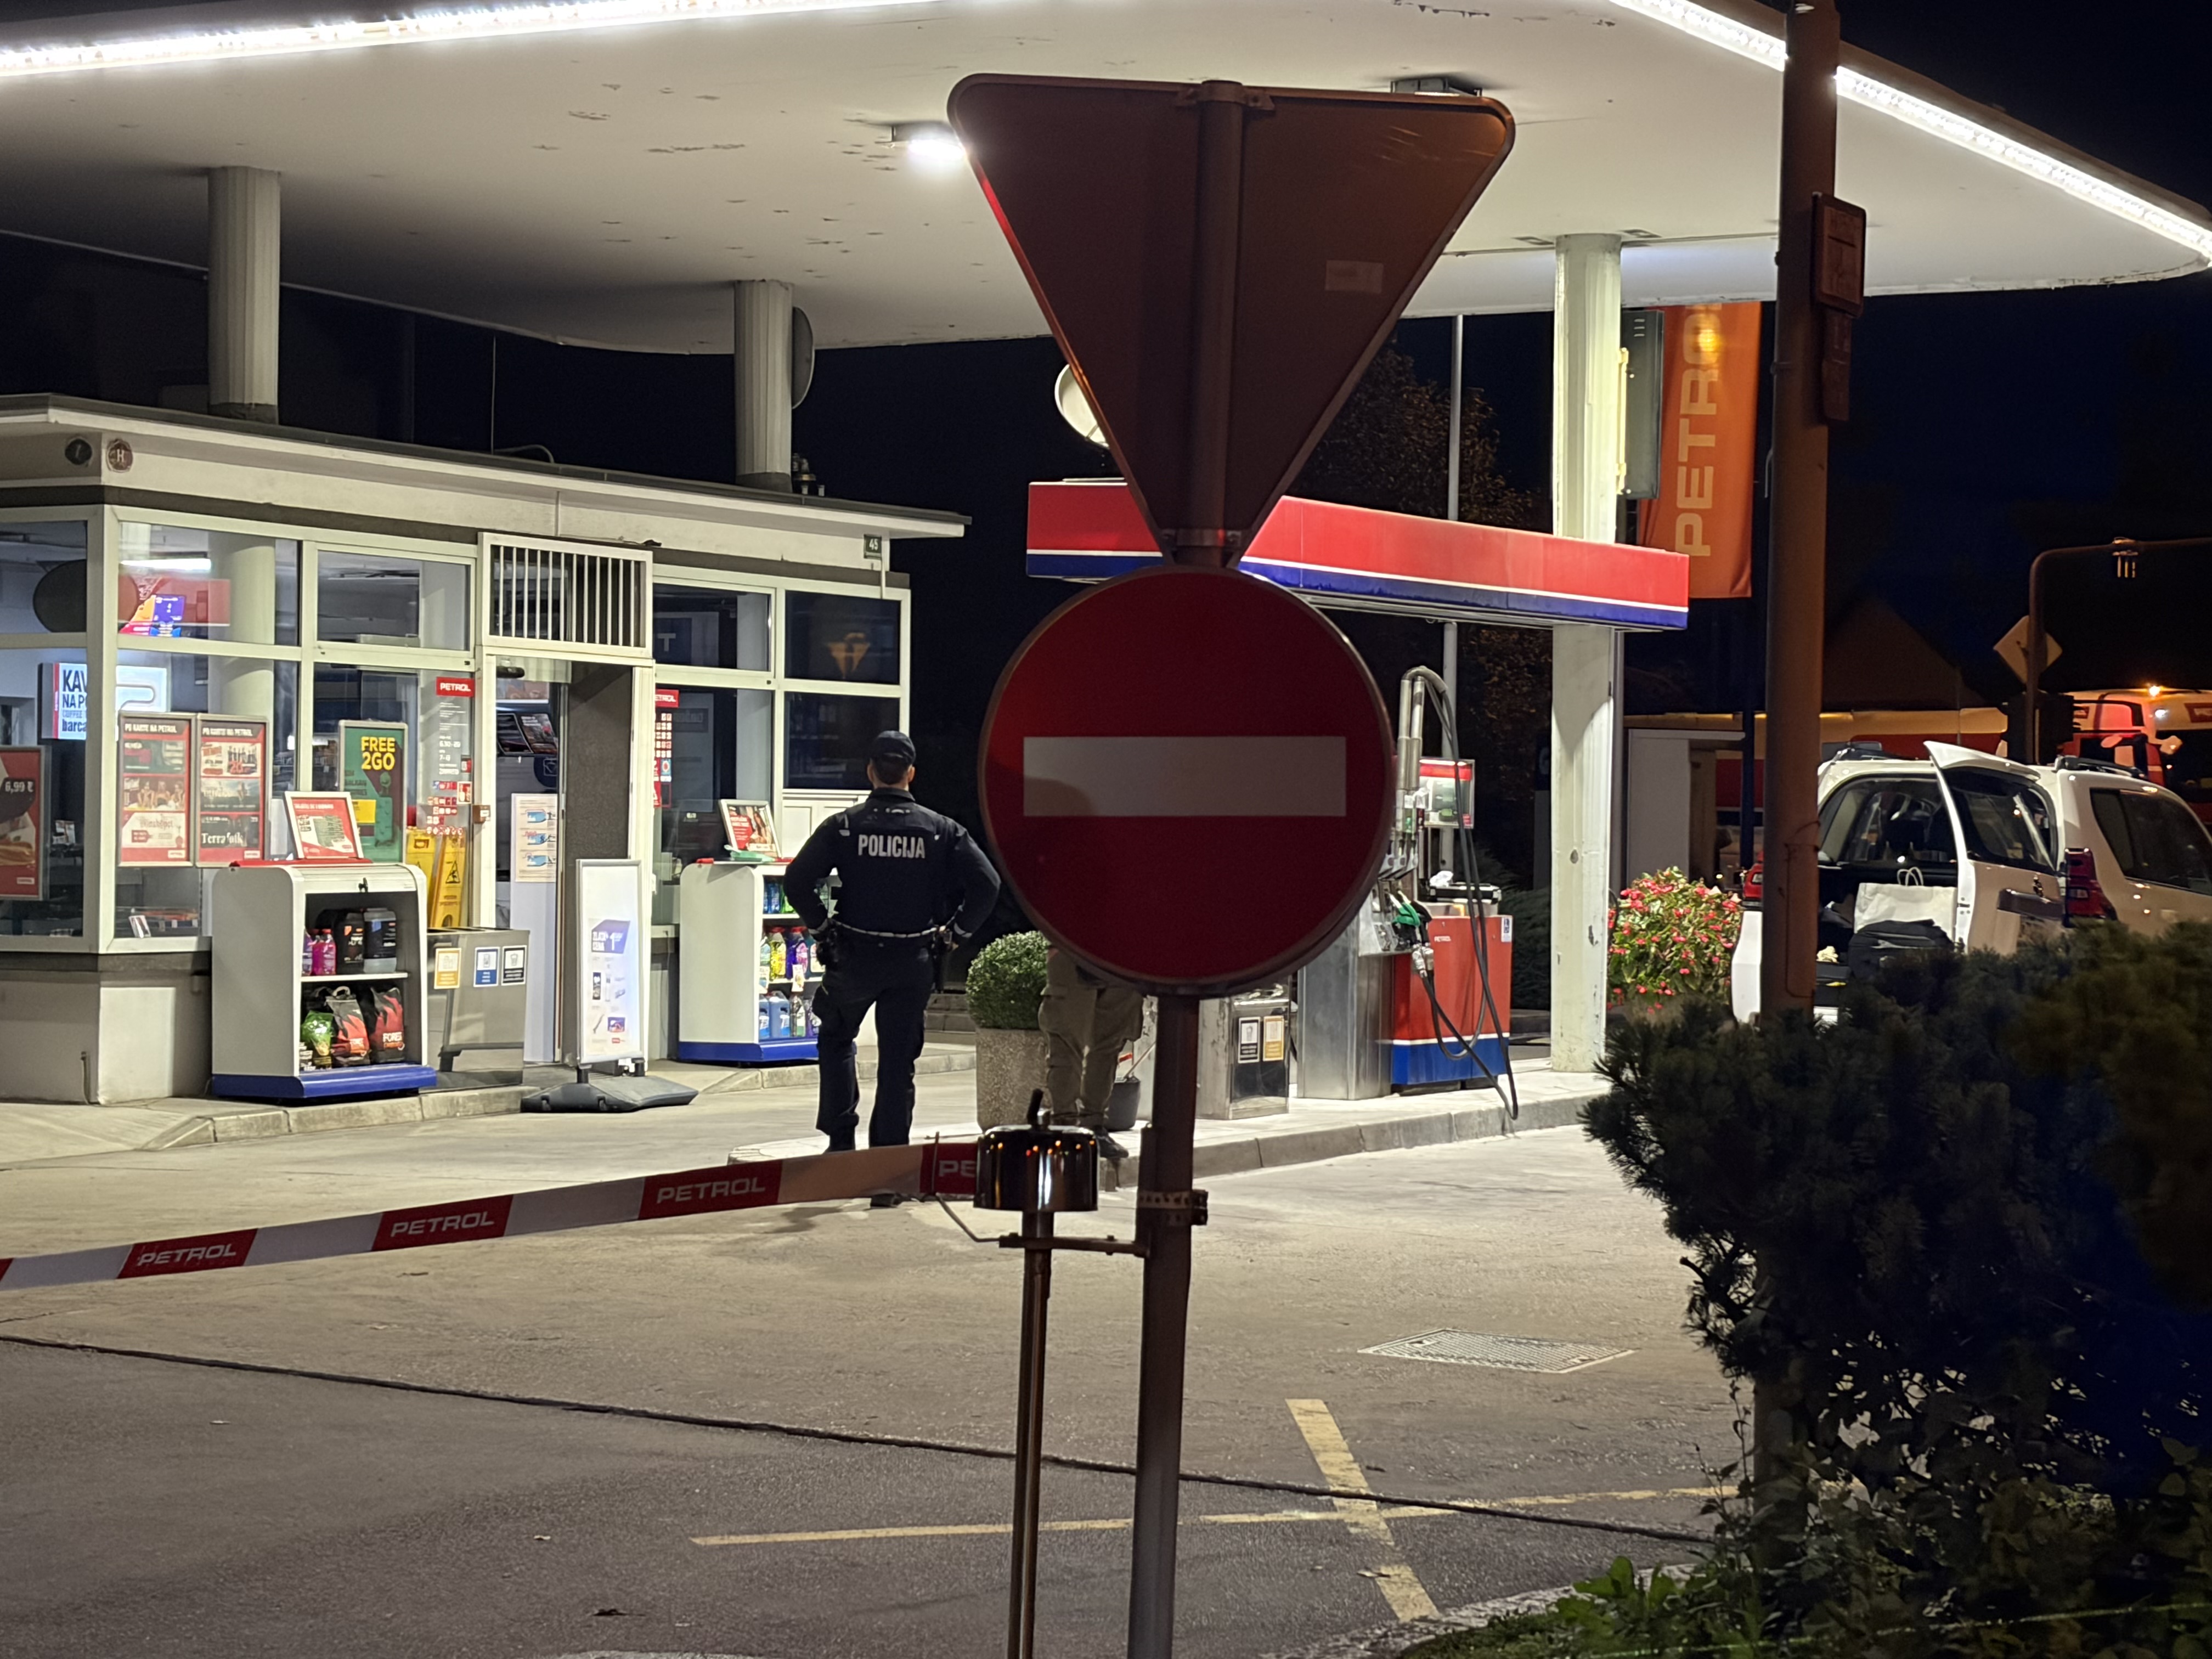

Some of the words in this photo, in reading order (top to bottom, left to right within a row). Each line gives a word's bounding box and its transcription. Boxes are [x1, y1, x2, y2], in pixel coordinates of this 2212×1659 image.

[1675, 303, 1722, 557] PETRO
[869, 538, 878, 550] 45
[440, 682, 471, 691] PETROL
[63, 693, 76, 708] NA
[361, 736, 395, 752] FREE
[361, 752, 395, 770] 2GO
[5, 781, 25, 794] 6,99
[858, 834, 926, 859] POLICIJA
[657, 1177, 766, 1204] PETROL
[391, 1211, 494, 1238] PETROL
[137, 1243, 236, 1266] PETROL
